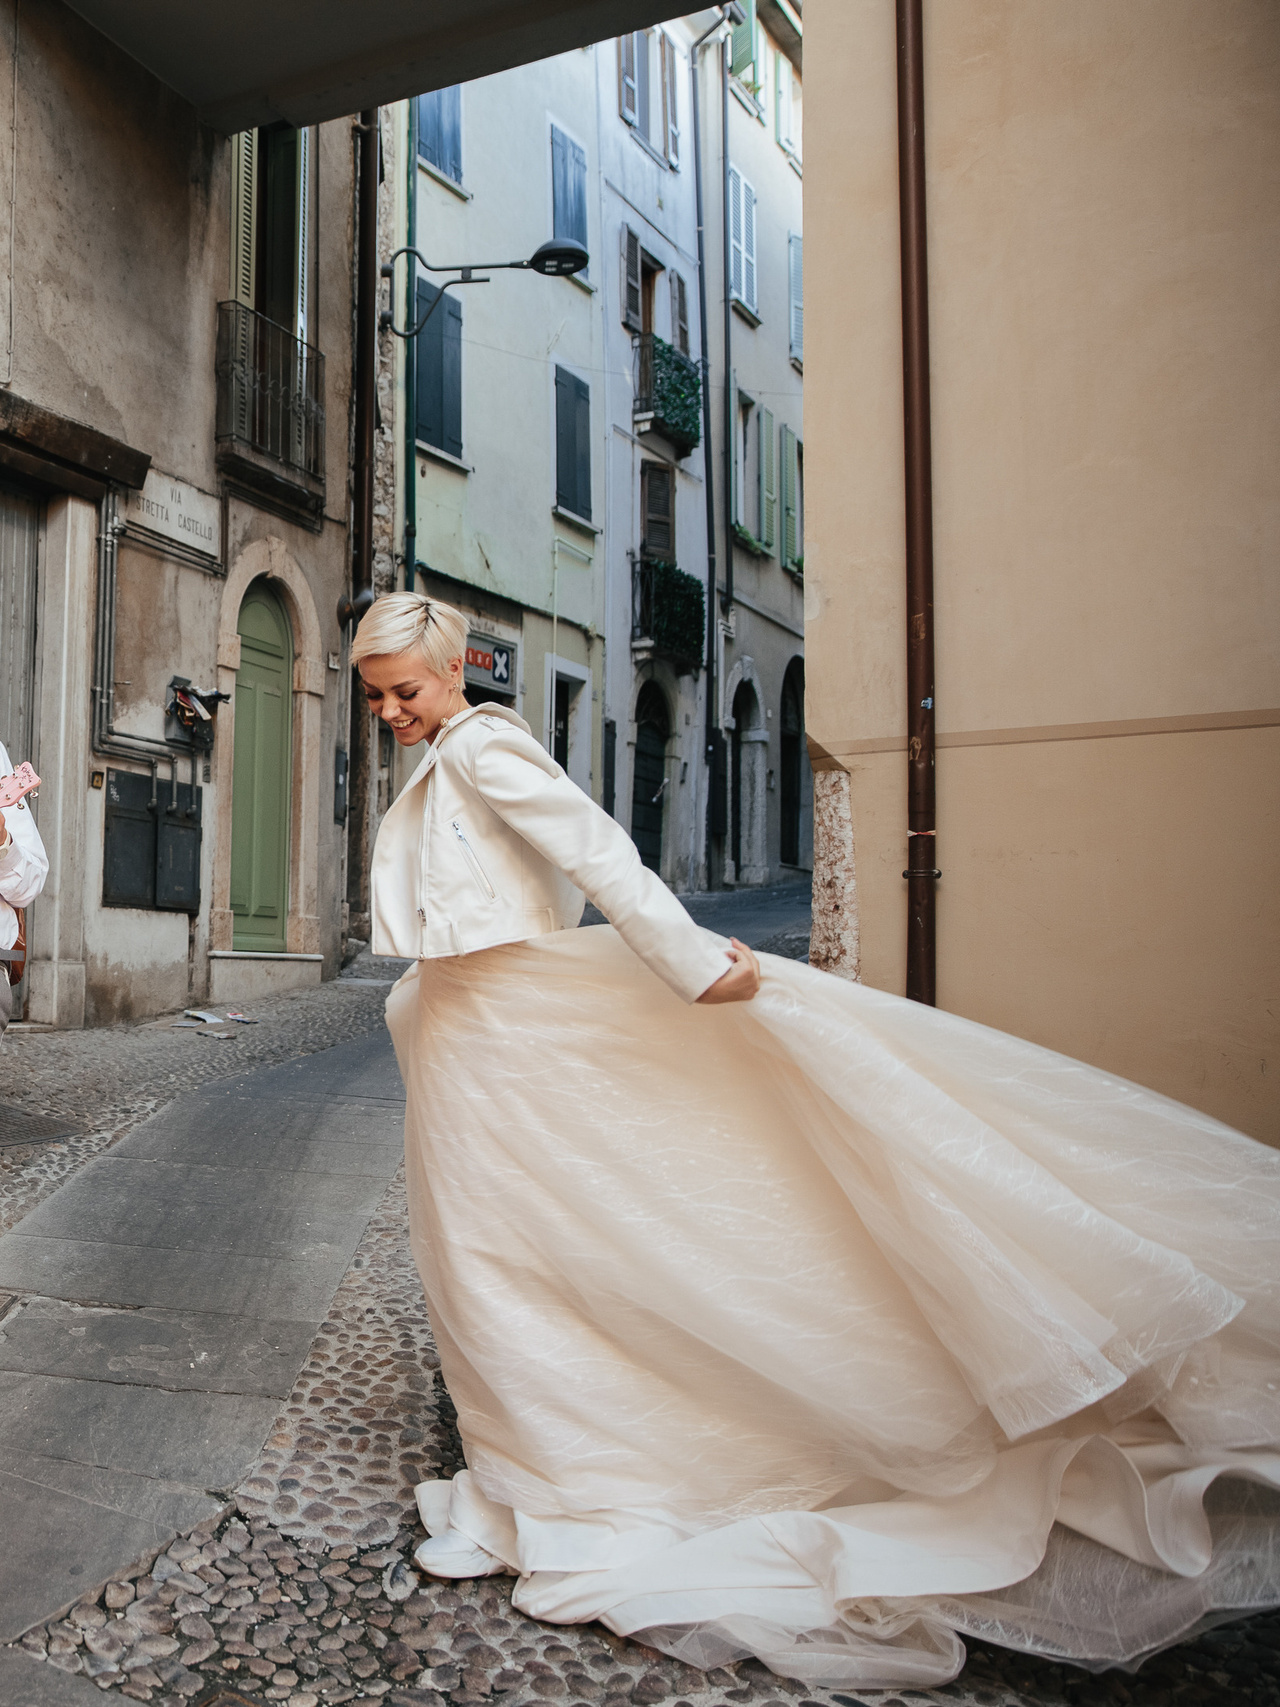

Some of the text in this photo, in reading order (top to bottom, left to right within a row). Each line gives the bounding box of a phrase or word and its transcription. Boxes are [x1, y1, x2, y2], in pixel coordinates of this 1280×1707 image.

[170, 487, 182, 505] VIA
[136, 496, 213, 541] STRETTA CASTELLO
